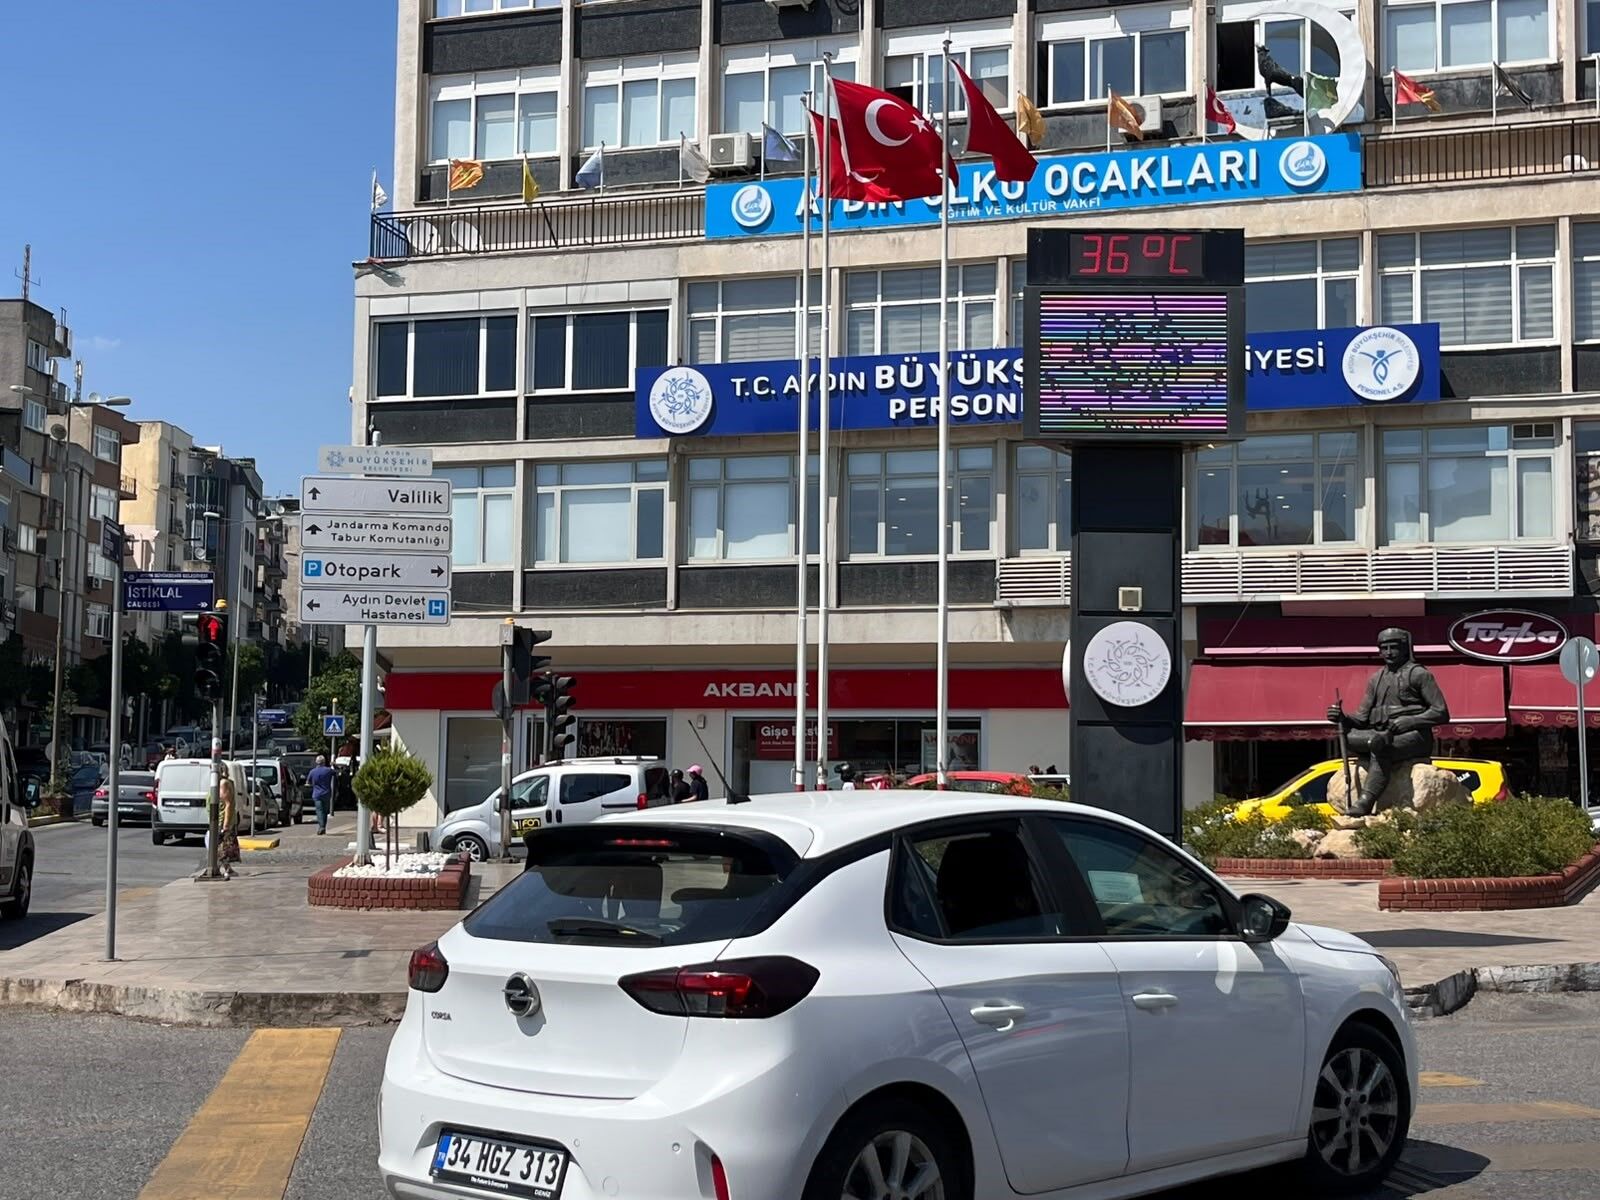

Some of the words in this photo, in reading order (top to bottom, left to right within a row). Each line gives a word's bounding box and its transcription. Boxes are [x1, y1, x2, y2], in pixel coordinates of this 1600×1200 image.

[1044, 148, 1257, 196] OCAKLARI
[985, 206, 1002, 216] VE
[1063, 197, 1100, 209] VAKFI
[731, 376, 776, 396] T.C.
[889, 393, 1023, 419] PERSON
[348, 454, 429, 467] BÜYÜKŞEHİR
[388, 489, 443, 505] Valilik
[326, 520, 389, 531] Jandarma
[392, 522, 449, 533] Komando
[331, 533, 366, 543] Tabur
[369, 534, 445, 547] Komutanlığı
[324, 562, 401, 581] Otopark
[128, 585, 183, 599] İSTİKLAL
[342, 594, 381, 606] Aydın
[385, 595, 426, 607] Devlet
[361, 609, 425, 621] Hastanesi
[761, 726, 789, 740] Gişe
[431, 1011, 452, 1021] CORSA
[447, 1137, 472, 1169] 34
[476, 1141, 518, 1177] HGZ
[520, 1149, 560, 1185] 313
